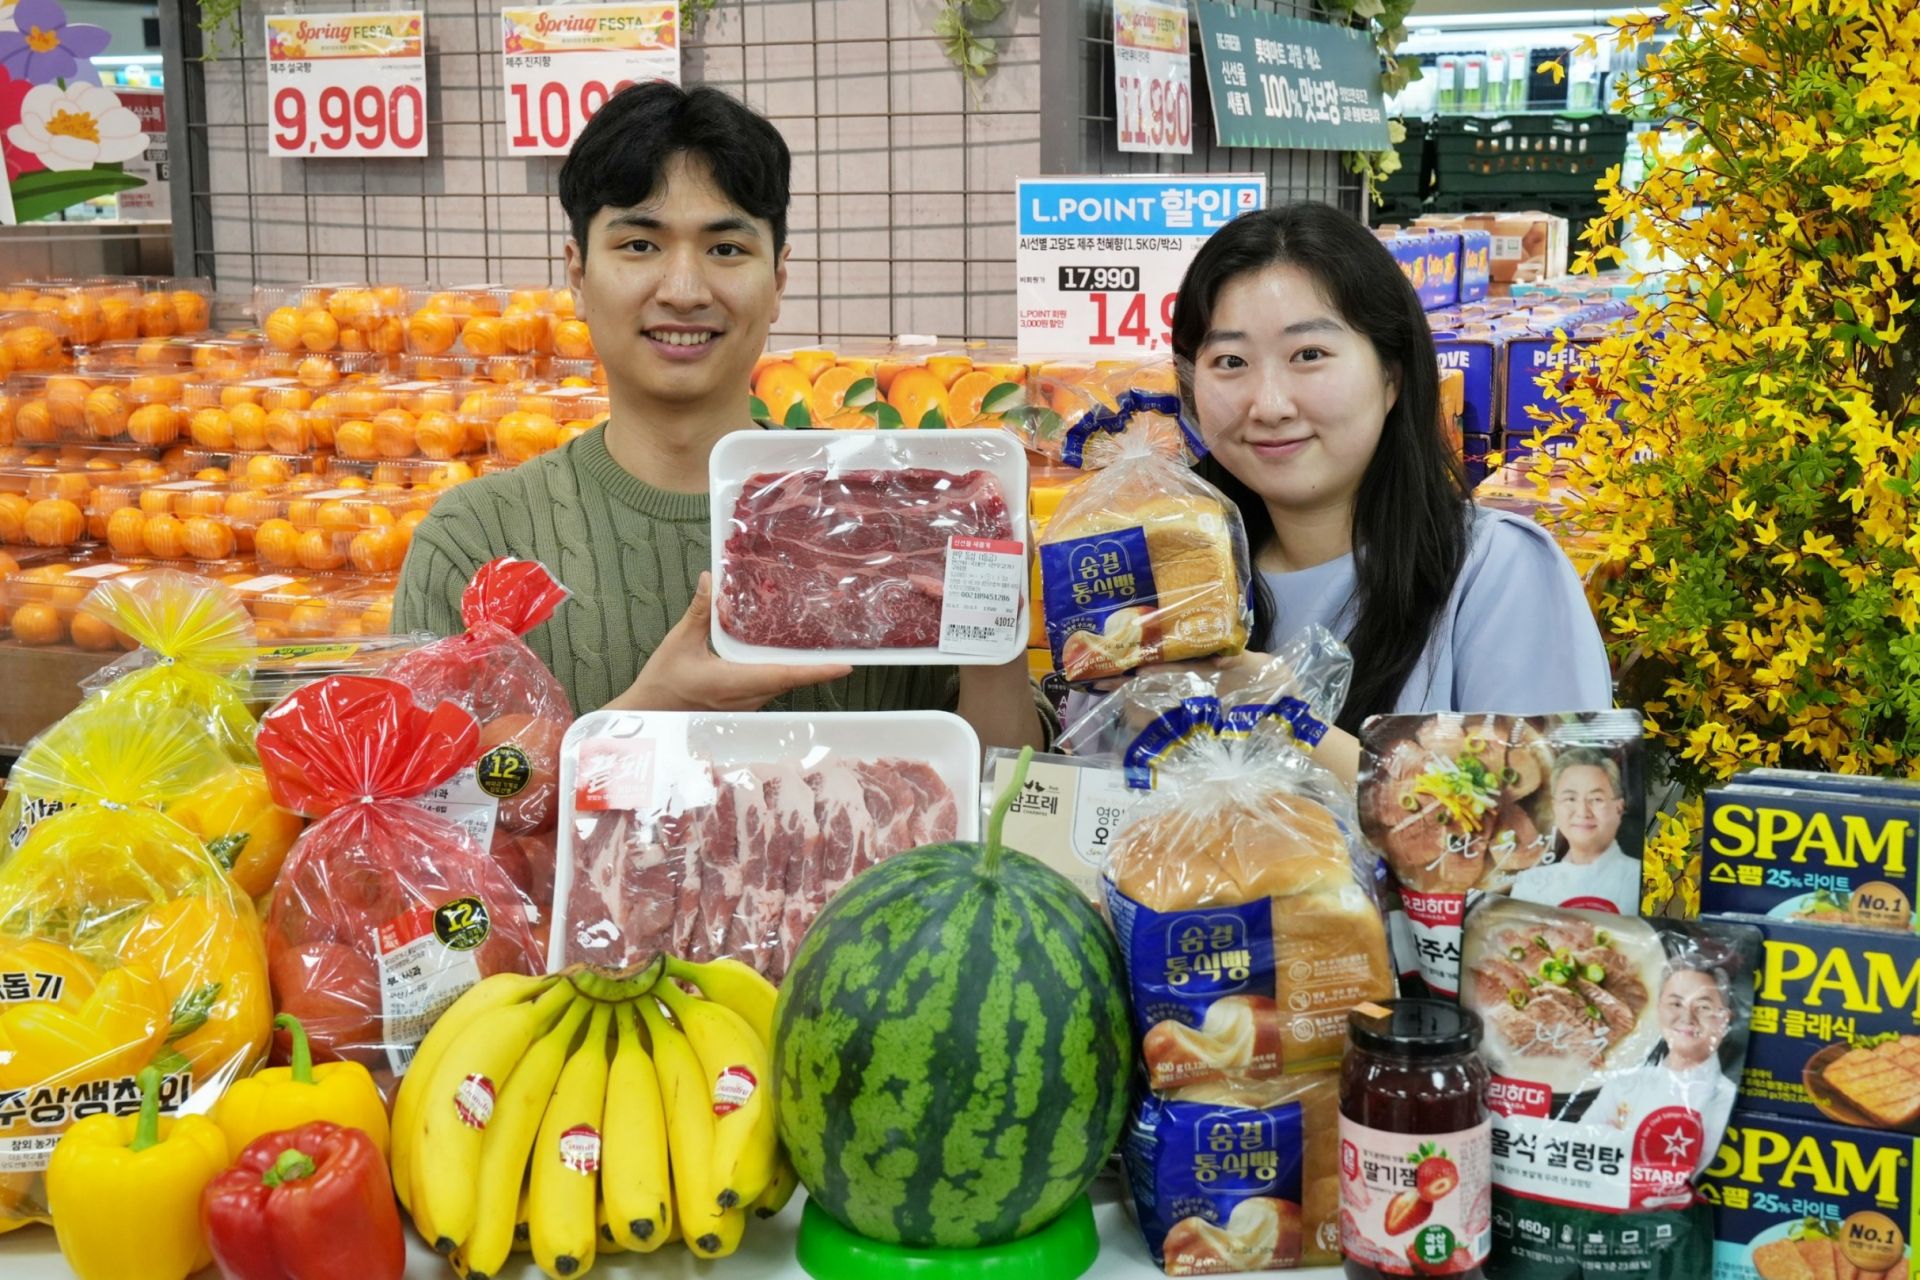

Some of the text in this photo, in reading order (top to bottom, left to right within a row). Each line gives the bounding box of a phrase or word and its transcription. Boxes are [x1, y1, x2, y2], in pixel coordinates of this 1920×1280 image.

[296, 20, 393, 43] Spring FESTA
[535, 12, 643, 35] Spring FESTA
[270, 63, 286, 74] 제주
[505, 56, 551, 68] 제주 진지향
[1222, 60, 1247, 86] 신선을
[1120, 76, 1190, 147] 11,990
[1227, 91, 1252, 116] 새롭게
[1259, 74, 1303, 118] 100%
[1298, 77, 1341, 126] 맛보장
[274, 84, 424, 154] 9,990
[1032, 197, 1156, 222] L.POINT
[1160, 188, 1231, 229] 할인
[1020, 239, 1050, 251] AI선별
[1050, 239, 1076, 251] 고당도
[1077, 239, 1095, 251] 제주
[1064, 268, 1135, 290] 17,990
[1020, 310, 1051, 318] L.POINT
[1436, 351, 1470, 368] OVE
[1081, 551, 1120, 579] 숨결
[1072, 574, 1137, 606] 통식빵
[489, 755, 519, 779] 12
[1709, 804, 1910, 872] SPAM
[1709, 863, 1851, 893] 스팸 25% 라이트
[443, 903, 475, 932] 12
[1180, 924, 1234, 954] 숨결
[1166, 950, 1251, 985] 통식빵
[0, 973, 62, 999] 돕기
[1754, 941, 1920, 1023] PAM
[1751, 1006, 1855, 1044] 팸 클래식
[1488, 1083, 1545, 1105] 리하다
[1207, 1120, 1263, 1151] 숨결
[1491, 1127, 1537, 1164] 울식
[1544, 1138, 1625, 1175] 설렁탕
[1704, 1126, 1902, 1203] SPAM
[1191, 1150, 1280, 1184] 통식빵
[1364, 1160, 1418, 1187] 딸기잼
[1699, 1183, 1842, 1220] 스팸 25% 라이트
[1517, 1218, 1551, 1239] 460g
